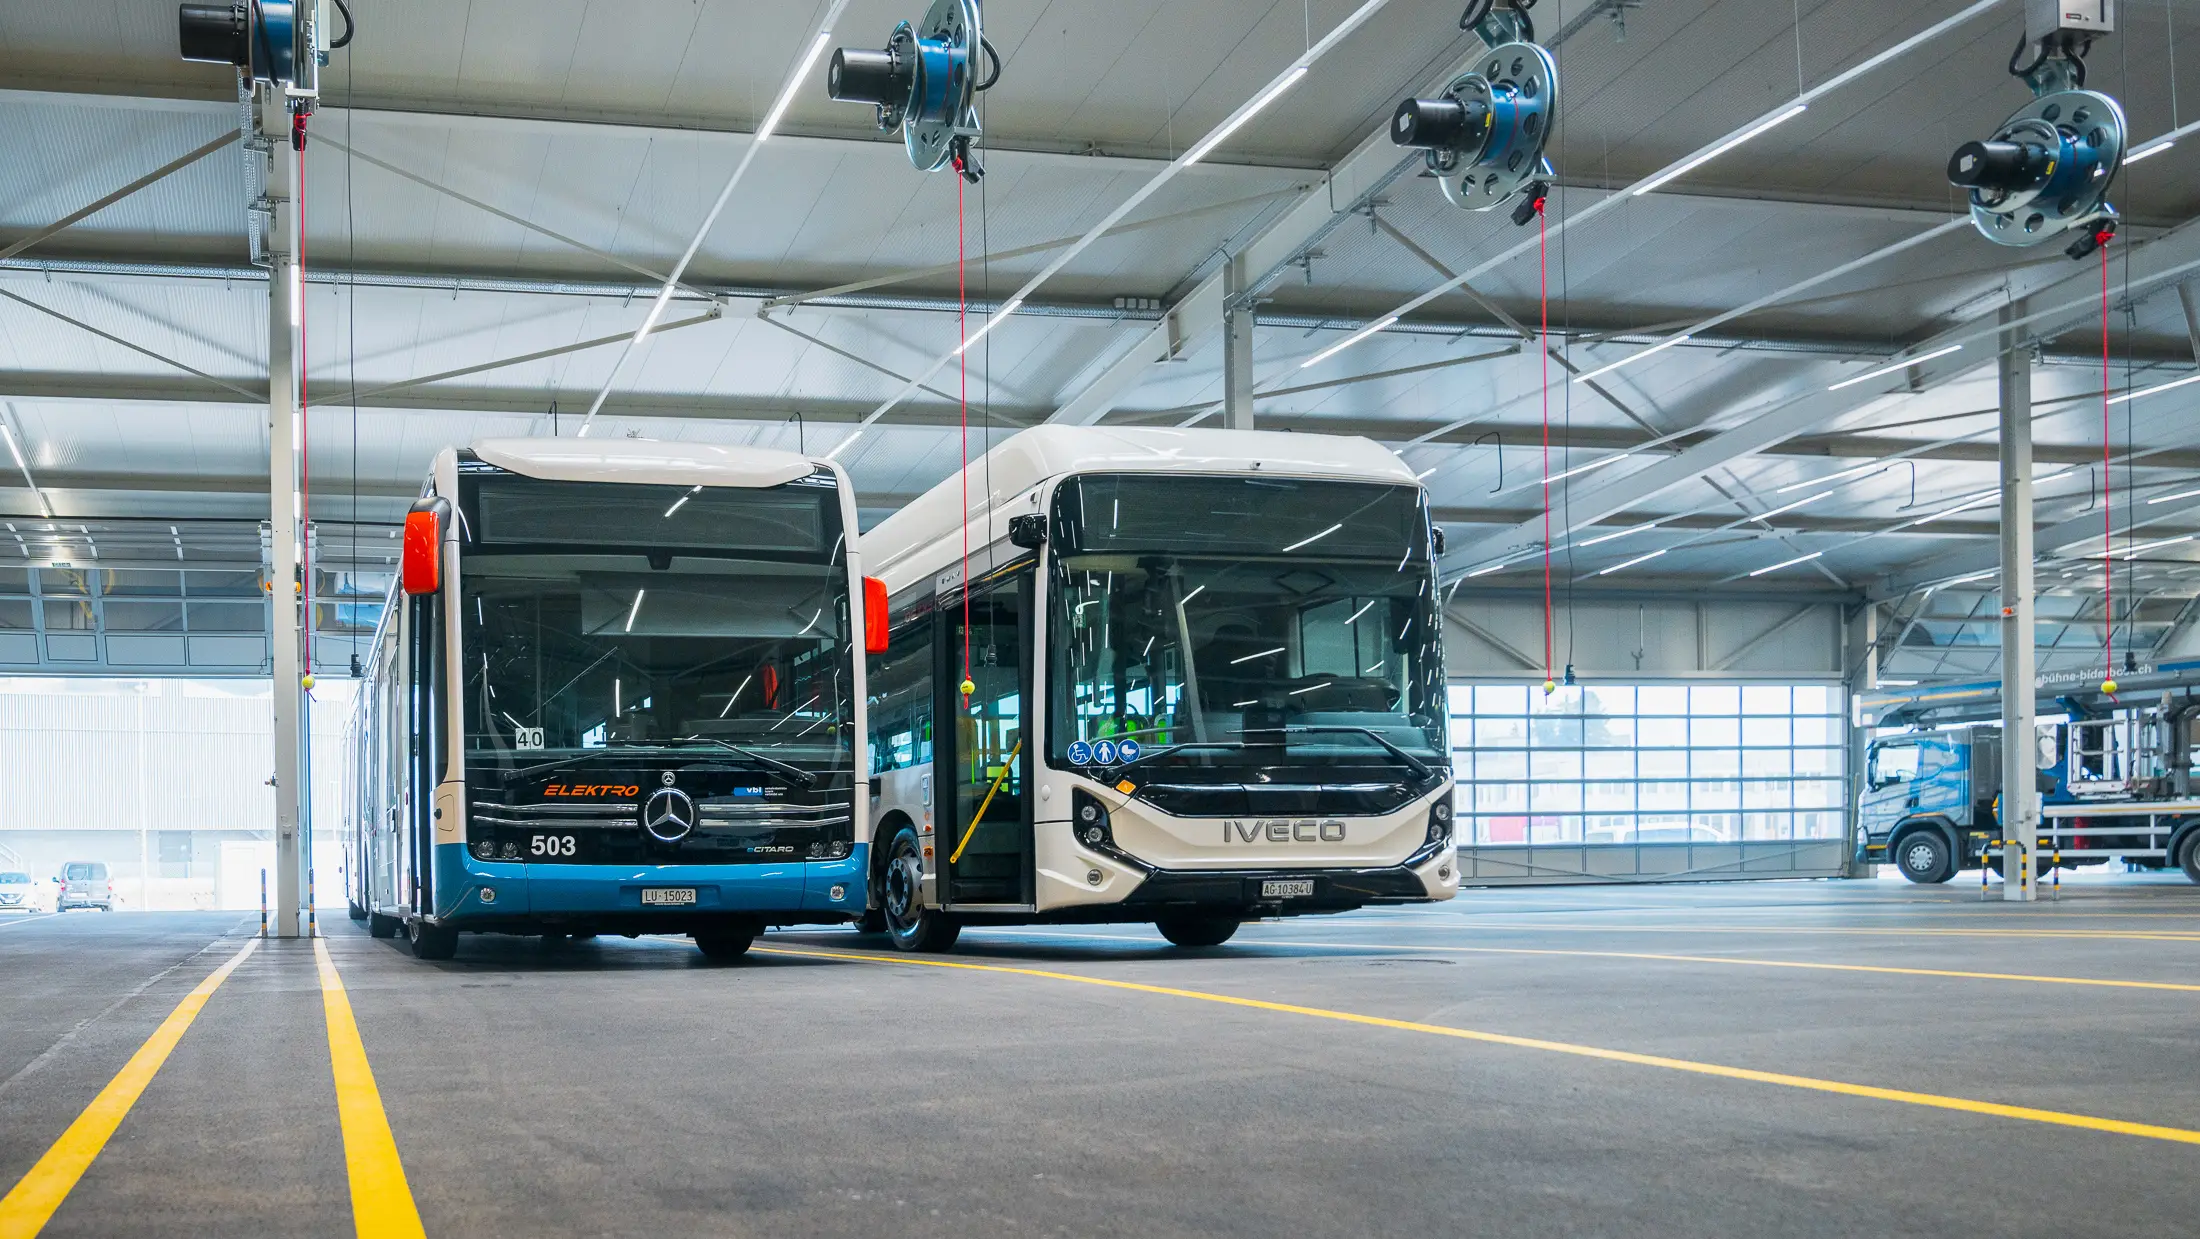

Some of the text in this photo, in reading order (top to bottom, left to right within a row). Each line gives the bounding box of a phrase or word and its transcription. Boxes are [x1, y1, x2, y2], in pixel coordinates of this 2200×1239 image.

[517, 731, 543, 747] 40
[543, 784, 640, 797] ELEKTRO
[746, 786, 762, 794] vbl
[1223, 819, 1347, 843] IVECO
[530, 835, 576, 856] 503
